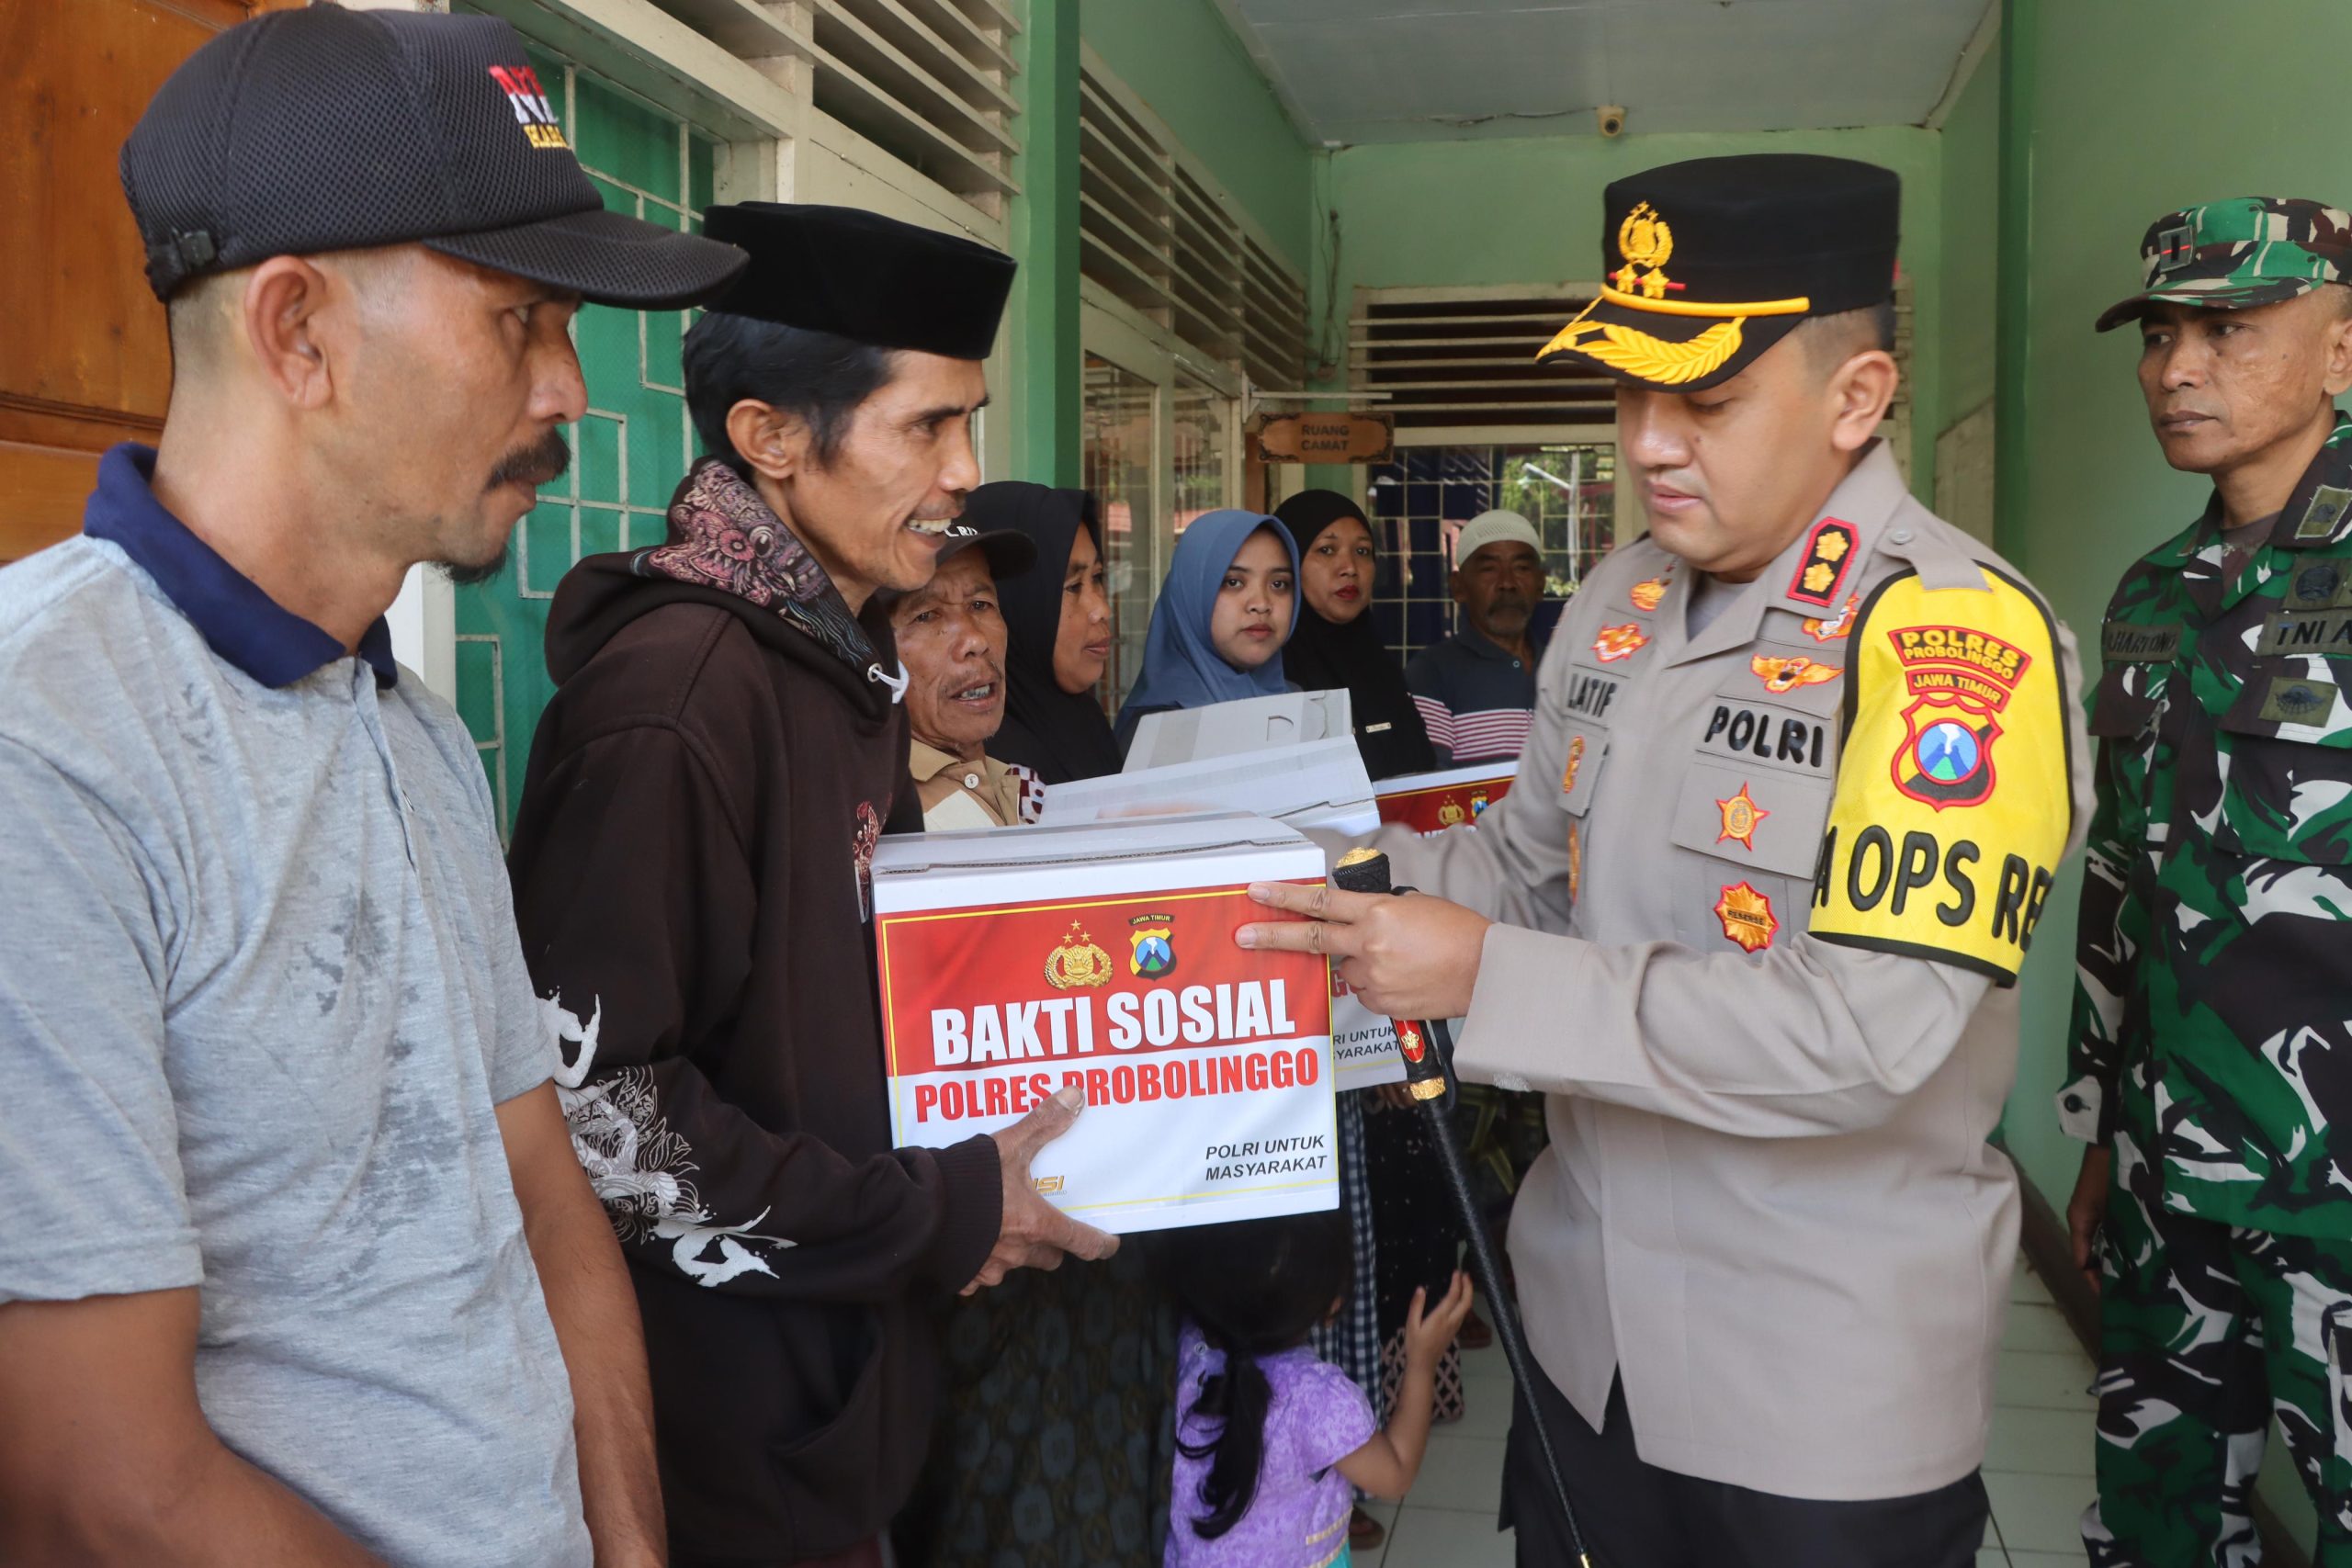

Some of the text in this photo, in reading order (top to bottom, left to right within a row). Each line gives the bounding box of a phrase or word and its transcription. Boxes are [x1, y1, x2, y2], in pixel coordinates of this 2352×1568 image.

[1301, 424, 1350, 435] RUANG
[1301, 440, 1350, 451] CAMAT
[2277, 621, 2327, 646] TNI
[1901, 630, 2019, 668] POLRES
[1904, 647, 2014, 680] PROBOLINGGO
[1567, 673, 1617, 717] LATIF
[1914, 674, 2002, 704] JAWA TIMUR
[1704, 705, 1824, 768] POLRI
[1848, 825, 1980, 927] OPS
[1133, 915, 1149, 924] JAWA
[931, 978, 1295, 1066] BAKTI SOSIAL
[1350, 1026, 1395, 1042] UNTUK
[1333, 1041, 1399, 1060] YARAKAT
[915, 1073, 1051, 1122] POLRES
[1206, 1134, 1325, 1160] POLRI UNTUK
[1205, 1155, 1328, 1182] MASYARAKAT
